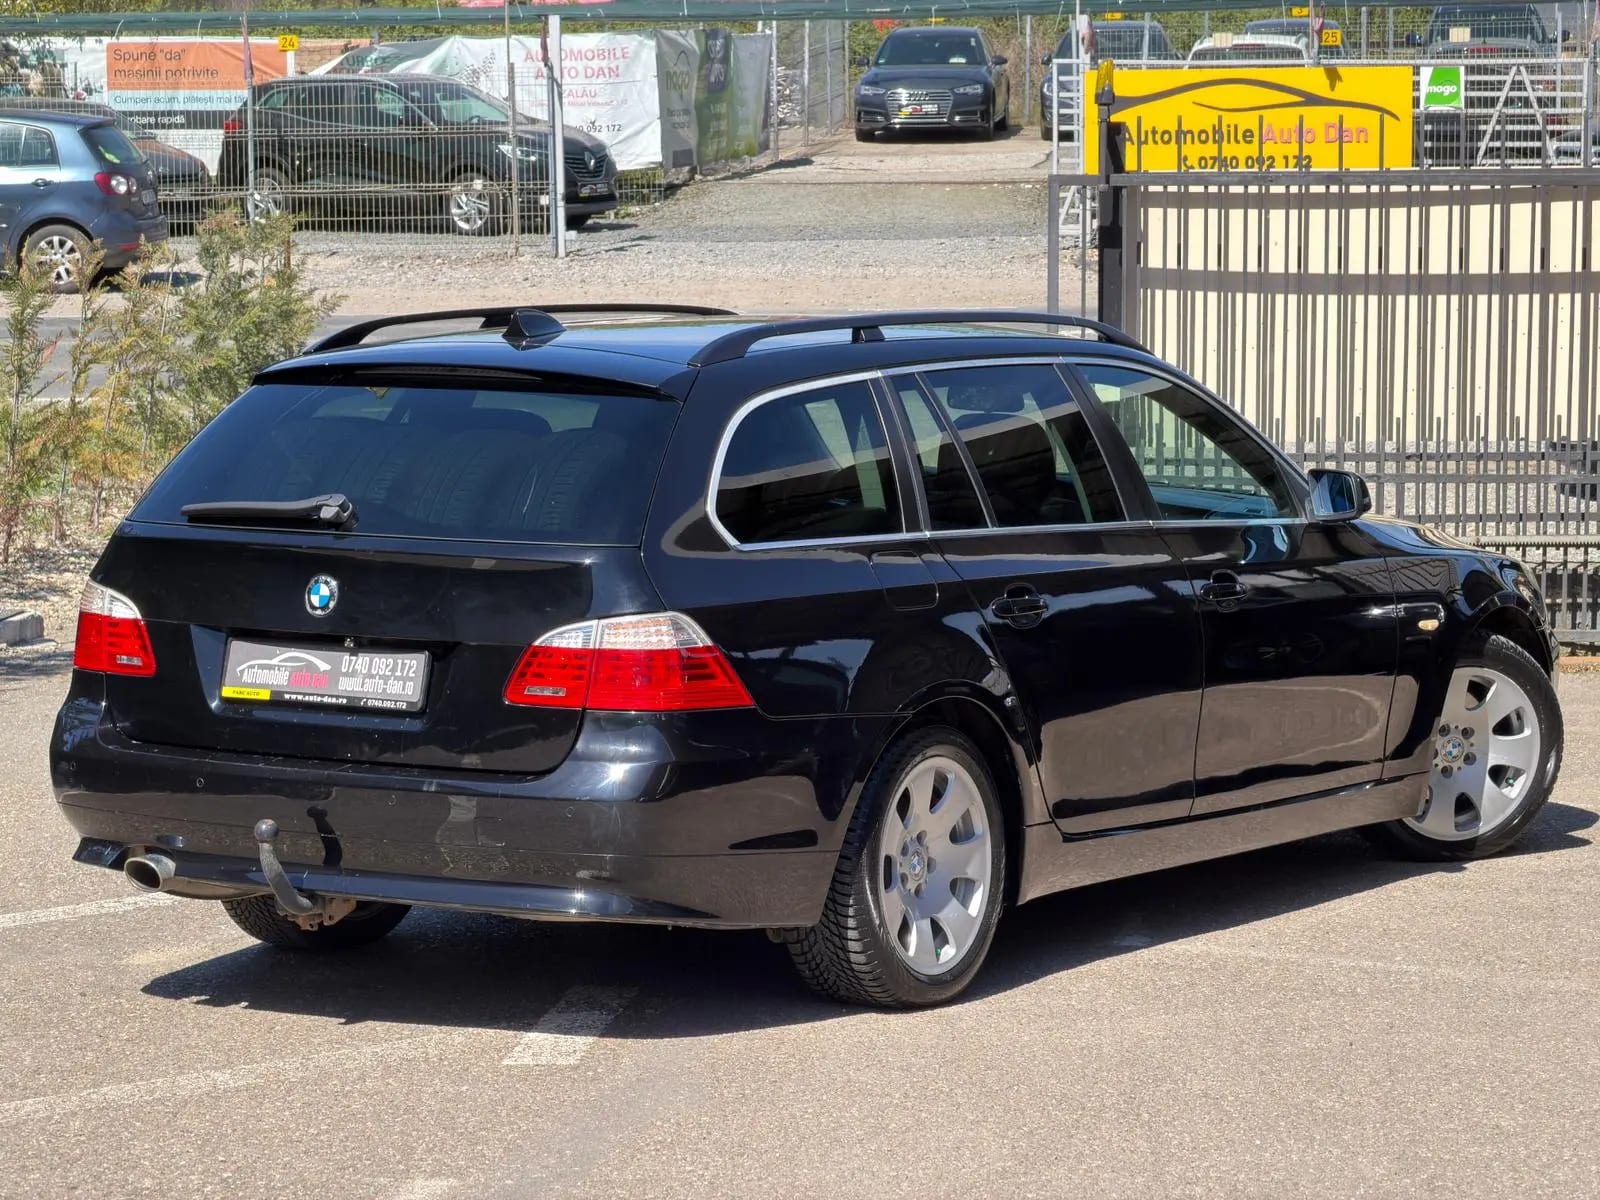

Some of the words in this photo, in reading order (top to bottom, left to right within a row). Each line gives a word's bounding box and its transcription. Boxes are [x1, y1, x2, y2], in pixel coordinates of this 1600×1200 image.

[281, 37, 295, 48] 24
[1323, 31, 1338, 43] 25
[113, 48, 157, 62] Spune
[159, 49, 186, 61] "da"
[525, 46, 629, 62] AUOMOBILE
[164, 67, 219, 81] potrivite
[535, 66, 579, 80] ATO
[584, 65, 620, 79] DAN
[1426, 84, 1457, 96] mogo
[586, 124, 602, 133] 092
[606, 123, 622, 132] 172
[1123, 123, 1254, 145] Automobile
[1262, 123, 1316, 144] Auto
[1325, 122, 1369, 144] Dan
[341, 655, 369, 674] 0740
[371, 657, 393, 675] 092
[395, 659, 417, 677] 172
[242, 665, 289, 686] Automobile
[338, 675, 414, 695] www.auto-dan.ro
[284, 693, 347, 704] www.auto-dan.ro
[367, 699, 407, 709] 0740.092.172
